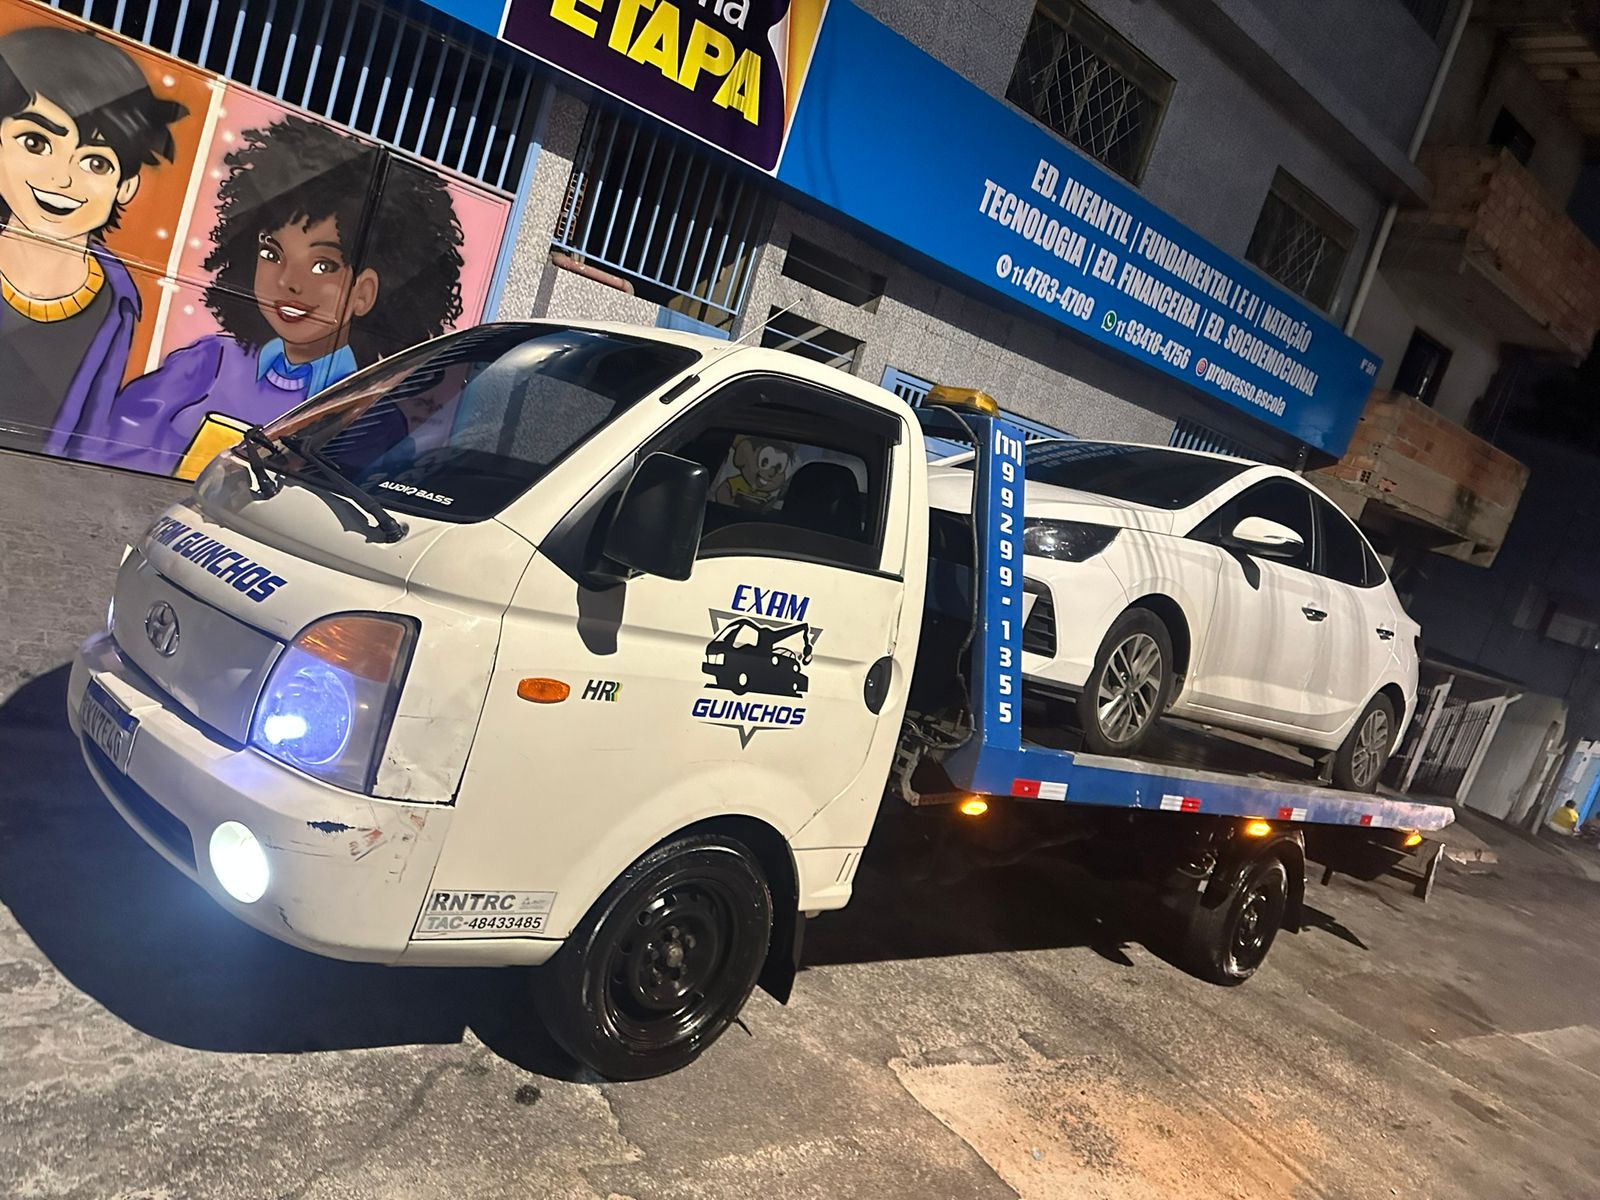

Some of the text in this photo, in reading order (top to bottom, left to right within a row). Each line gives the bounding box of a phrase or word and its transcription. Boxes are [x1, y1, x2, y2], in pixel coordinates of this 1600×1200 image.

[1031, 158, 1060, 203] ED.
[1059, 177, 1133, 246] INFANTIL
[1137, 226, 1234, 306] FUNDAMENTAL
[1236, 288, 1250, 316] E
[1260, 304, 1313, 354] NATAÇÃO
[979, 178, 1087, 268] TECNOLOGIA
[1092, 247, 1118, 286] ED.
[1116, 262, 1201, 331] FINANCEIRA
[1203, 312, 1225, 345] ED.
[1223, 324, 1319, 398] SOCIOEMOCIONAL
[1022, 266, 1095, 321] 4783-4709
[1124, 319, 1192, 371] 93418-4756
[1204, 362, 1287, 418] progresso.escola
[995, 430, 1023, 466] (11)
[415, 489, 455, 506] BASS
[171, 531, 288, 603] GUINCHOS
[731, 584, 810, 621] EXAM
[692, 698, 806, 725] GUINCHOS
[427, 916, 542, 930] TAC-48433485
[431, 892, 516, 911] RNTRC
